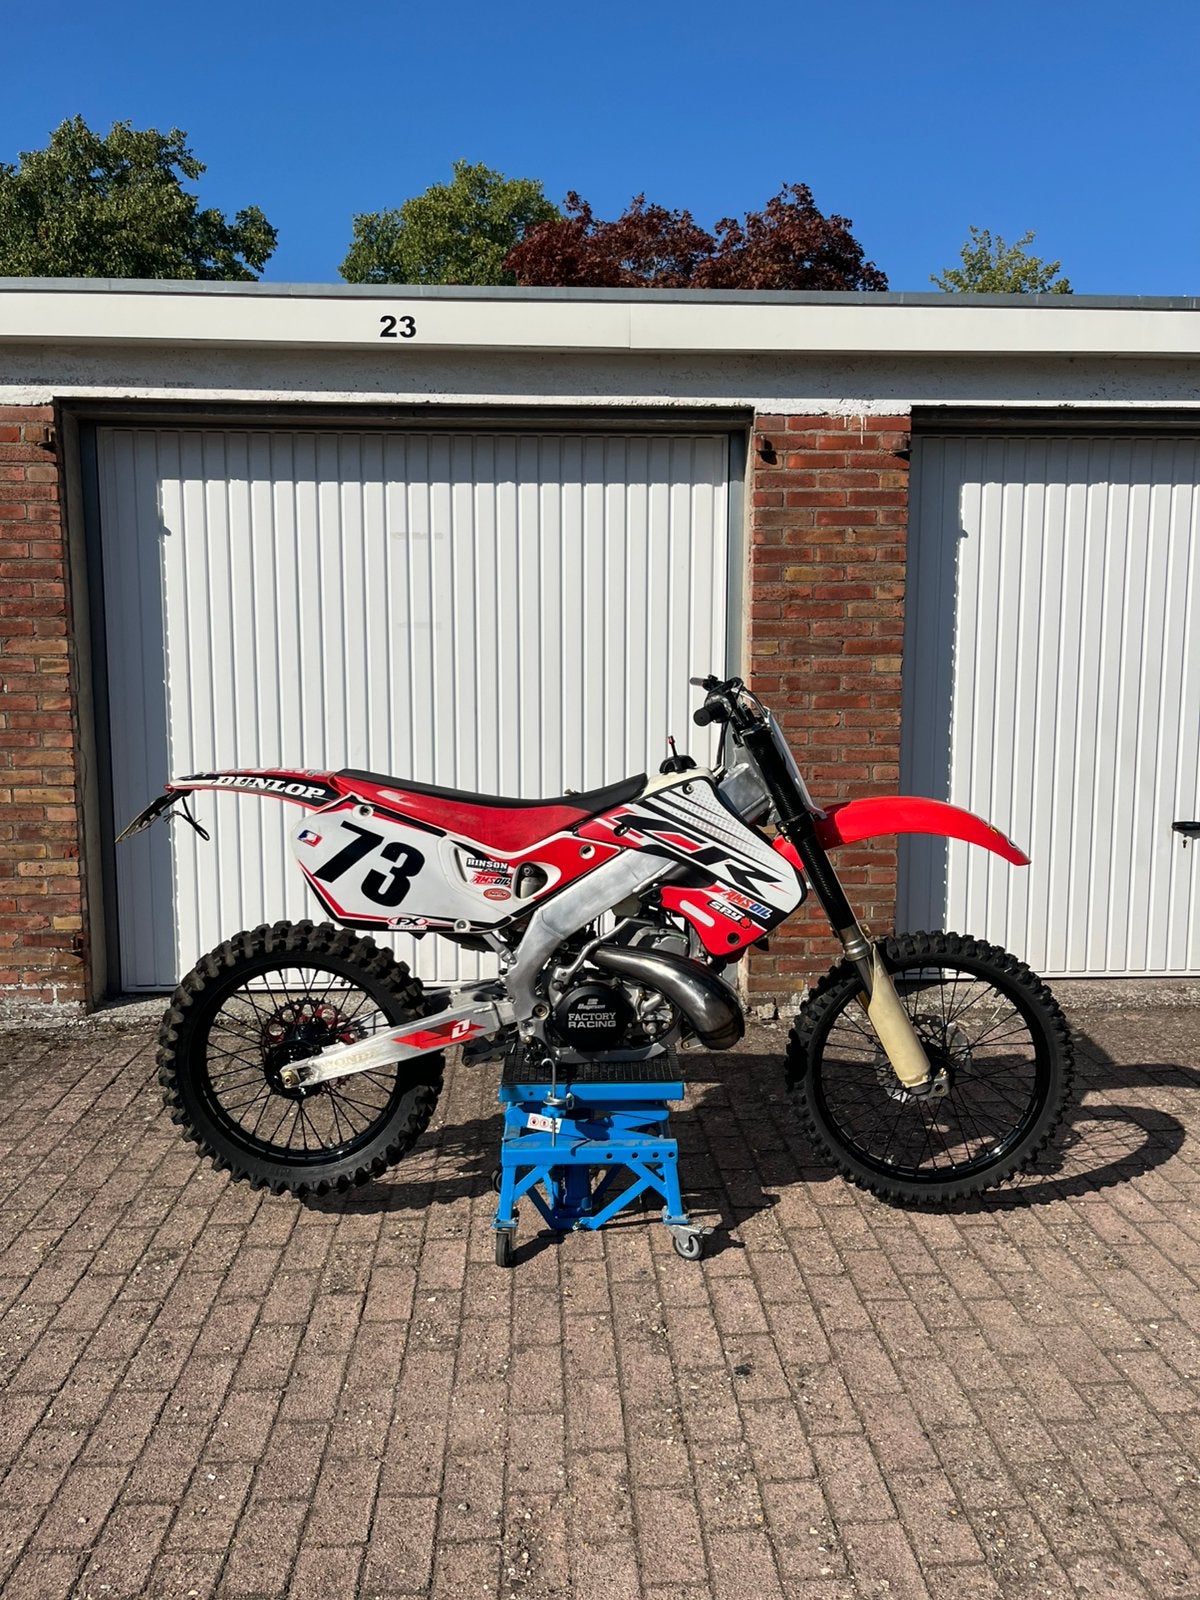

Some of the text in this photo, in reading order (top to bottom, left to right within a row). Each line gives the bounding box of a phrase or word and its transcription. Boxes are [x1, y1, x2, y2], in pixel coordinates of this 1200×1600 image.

[380, 315, 416, 338] 23
[212, 776, 326, 798] DUNLOP
[313, 820, 426, 908] 73
[722, 889, 773, 920] AMSOIL
[568, 1012, 616, 1021] FACTORY
[568, 1020, 616, 1028] RACING
